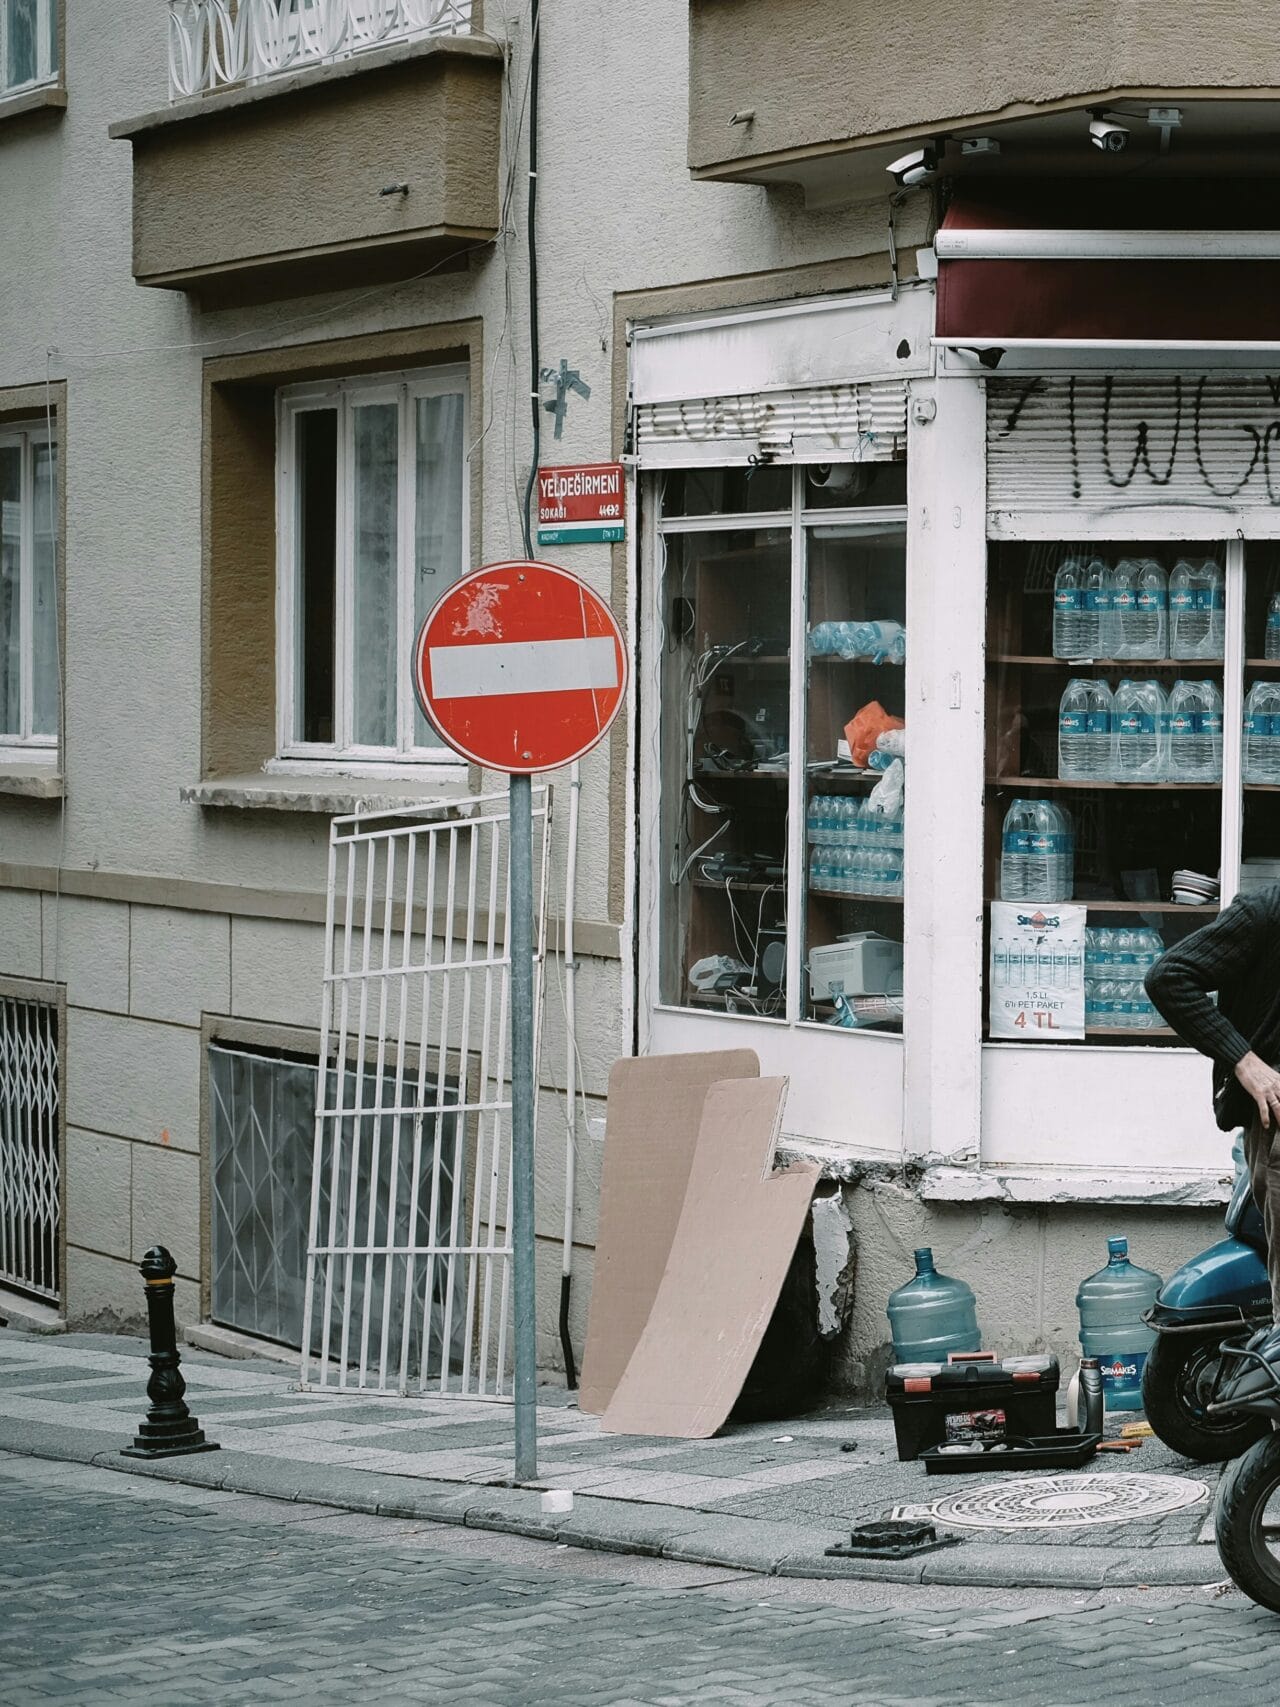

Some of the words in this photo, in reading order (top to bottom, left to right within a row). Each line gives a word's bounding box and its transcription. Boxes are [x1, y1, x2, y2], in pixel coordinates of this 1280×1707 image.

[540, 471, 620, 497] YELDEĞİRMENİ
[540, 505, 567, 520] SOKAĞI
[1018, 1001, 1034, 1009] PET
[1037, 1001, 1065, 1010] PAKET
[1014, 1011, 1027, 1029] 4
[1033, 1012, 1060, 1029] TL
